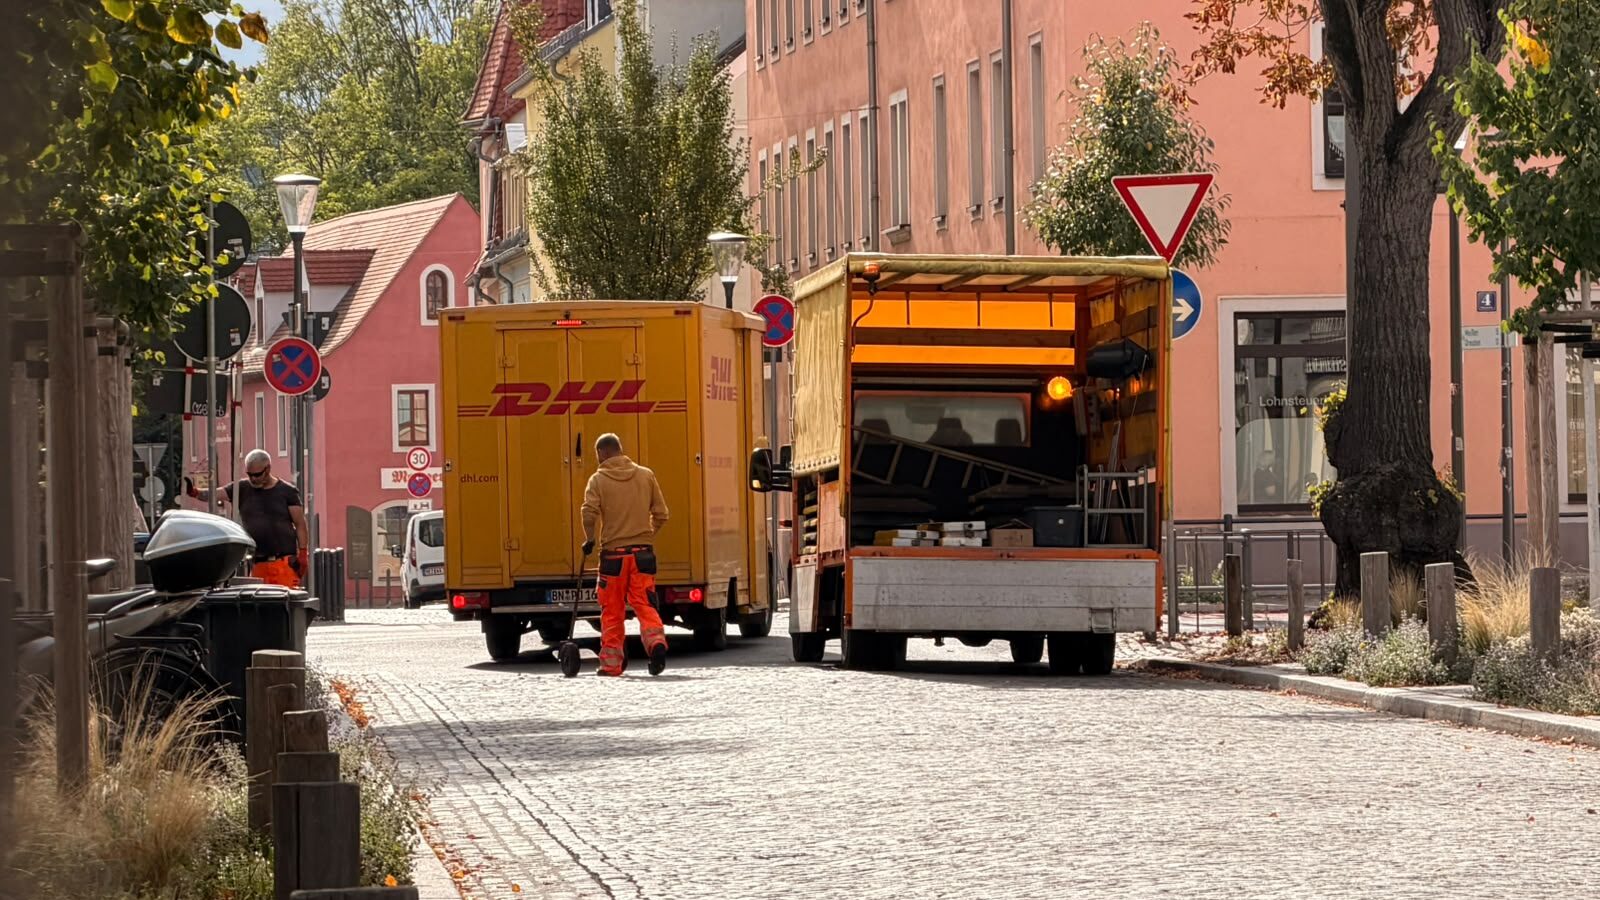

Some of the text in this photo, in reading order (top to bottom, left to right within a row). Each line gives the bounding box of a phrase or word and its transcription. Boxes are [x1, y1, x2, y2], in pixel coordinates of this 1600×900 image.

[1481, 293, 1492, 306] 4
[488, 380, 656, 417] DHL
[1259, 395, 1326, 407] Lohnsteuer
[412, 453, 426, 465] 30
[460, 473, 499, 483] dhl.com
[552, 590, 564, 601] BN
